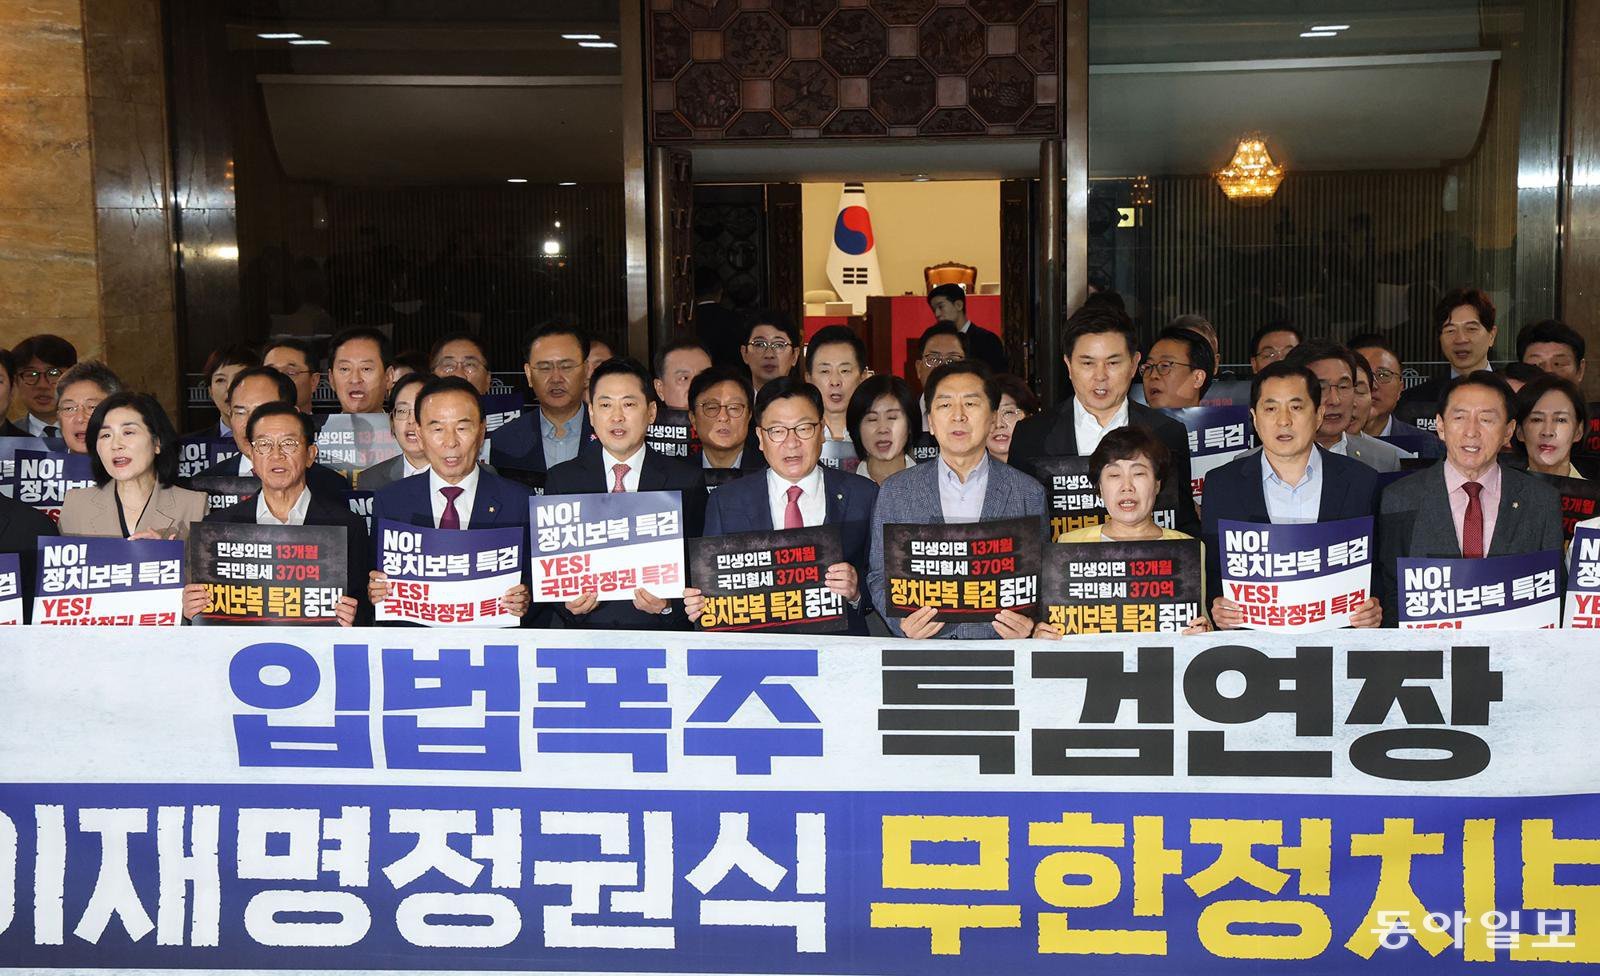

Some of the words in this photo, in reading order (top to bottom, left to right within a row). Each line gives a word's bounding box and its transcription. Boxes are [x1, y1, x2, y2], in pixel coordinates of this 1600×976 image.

[314, 431, 355, 445] 생외면
[1204, 423, 1244, 449] 특검
[314, 449, 356, 463] 민혈세
[647, 441, 688, 457] 민혈세
[21, 458, 64, 480] NO!
[20, 480, 97, 503] 정치
[1052, 475, 1096, 491] 민생외
[536, 501, 581, 527] NO!
[383, 529, 422, 553] NO!
[537, 517, 630, 552] 정치보복
[635, 510, 679, 537] 특검
[1225, 530, 1270, 553] NO!
[43, 543, 88, 568] NO!
[217, 542, 273, 559] 민생외면
[276, 544, 319, 560] 13개월
[716, 551, 772, 570] 민생외면
[774, 546, 816, 564] 13개월
[911, 541, 968, 556] 민생외면
[970, 537, 1014, 556] 13개월
[1226, 548, 1321, 578] 정치보복
[1327, 535, 1369, 567] 특검
[216, 562, 273, 580] 국민혈세
[276, 564, 321, 581] 370억
[382, 551, 470, 577] 정치보복
[476, 545, 519, 572] 특검
[540, 553, 591, 577] YES!
[910, 559, 969, 576] 국민혈세
[971, 557, 1015, 576] 370억
[1069, 561, 1126, 578] 민생외면
[1129, 560, 1173, 577] 13개월
[42, 563, 133, 592] 정치보복
[138, 559, 181, 585] 특검
[541, 568, 637, 598] 국민참정권
[641, 562, 679, 585] 특검
[717, 571, 774, 590] 국민혈세
[776, 567, 819, 586] 370억
[1404, 566, 1451, 591] NO!
[267, 587, 302, 617] 특검
[889, 578, 960, 609] 정치보복
[963, 580, 997, 609] 특검
[999, 575, 1037, 608] 중단!
[1068, 582, 1127, 599] 국민혈세
[1129, 581, 1175, 598] 370억
[1230, 583, 1279, 604] YES!
[1331, 589, 1366, 615] 특검
[1405, 582, 1505, 617] 정치보복
[1512, 569, 1556, 601] 특검
[42, 597, 93, 618] YES!
[383, 598, 474, 623] 국민참정권
[700, 593, 767, 628] 정치보복
[770, 590, 804, 621] 특검
[804, 587, 843, 618] 중단!
[1048, 604, 1118, 635] 정치보복
[1122, 603, 1156, 633] 특검
[229, 642, 824, 775] 입법폭주
[878, 645, 1503, 781] 특검연장
[0, 804, 827, 953] 이재명정권식
